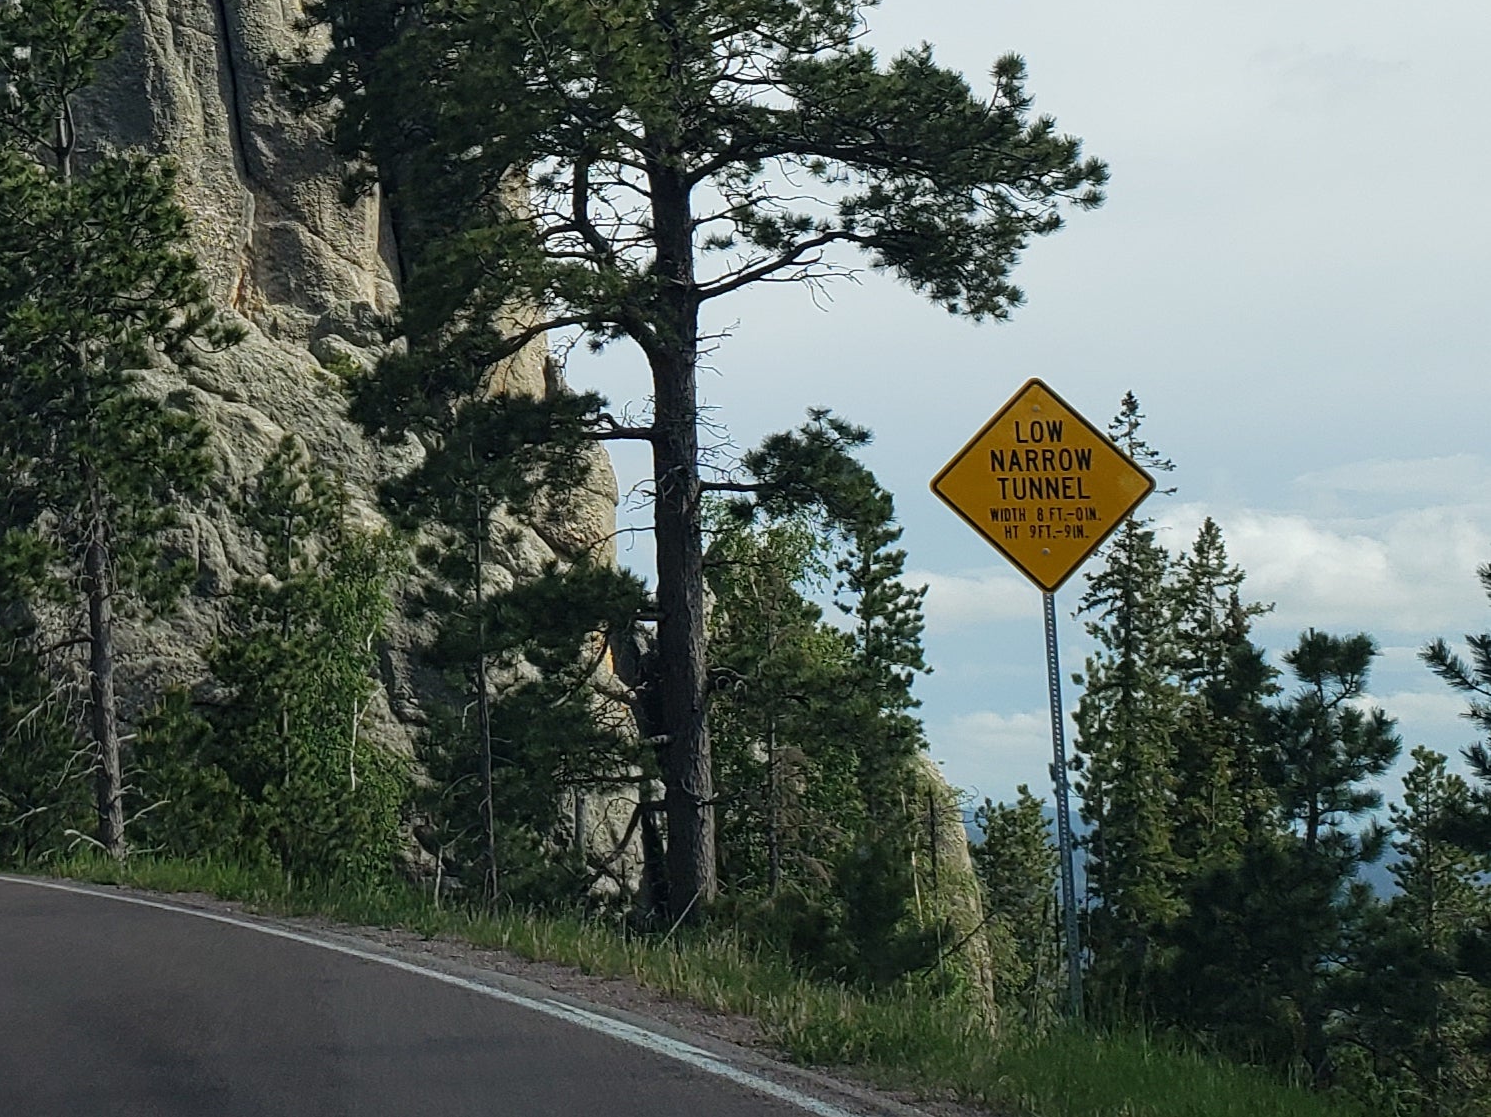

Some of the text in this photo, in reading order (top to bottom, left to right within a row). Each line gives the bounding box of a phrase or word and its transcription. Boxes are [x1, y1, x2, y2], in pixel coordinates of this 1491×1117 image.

[1014, 420, 1063, 444] LOW
[990, 448, 1092, 472] NARROW
[997, 477, 1091, 501] TUNNEL
[989, 507, 1026, 522] WIDTH
[1004, 525, 1019, 539] HT
